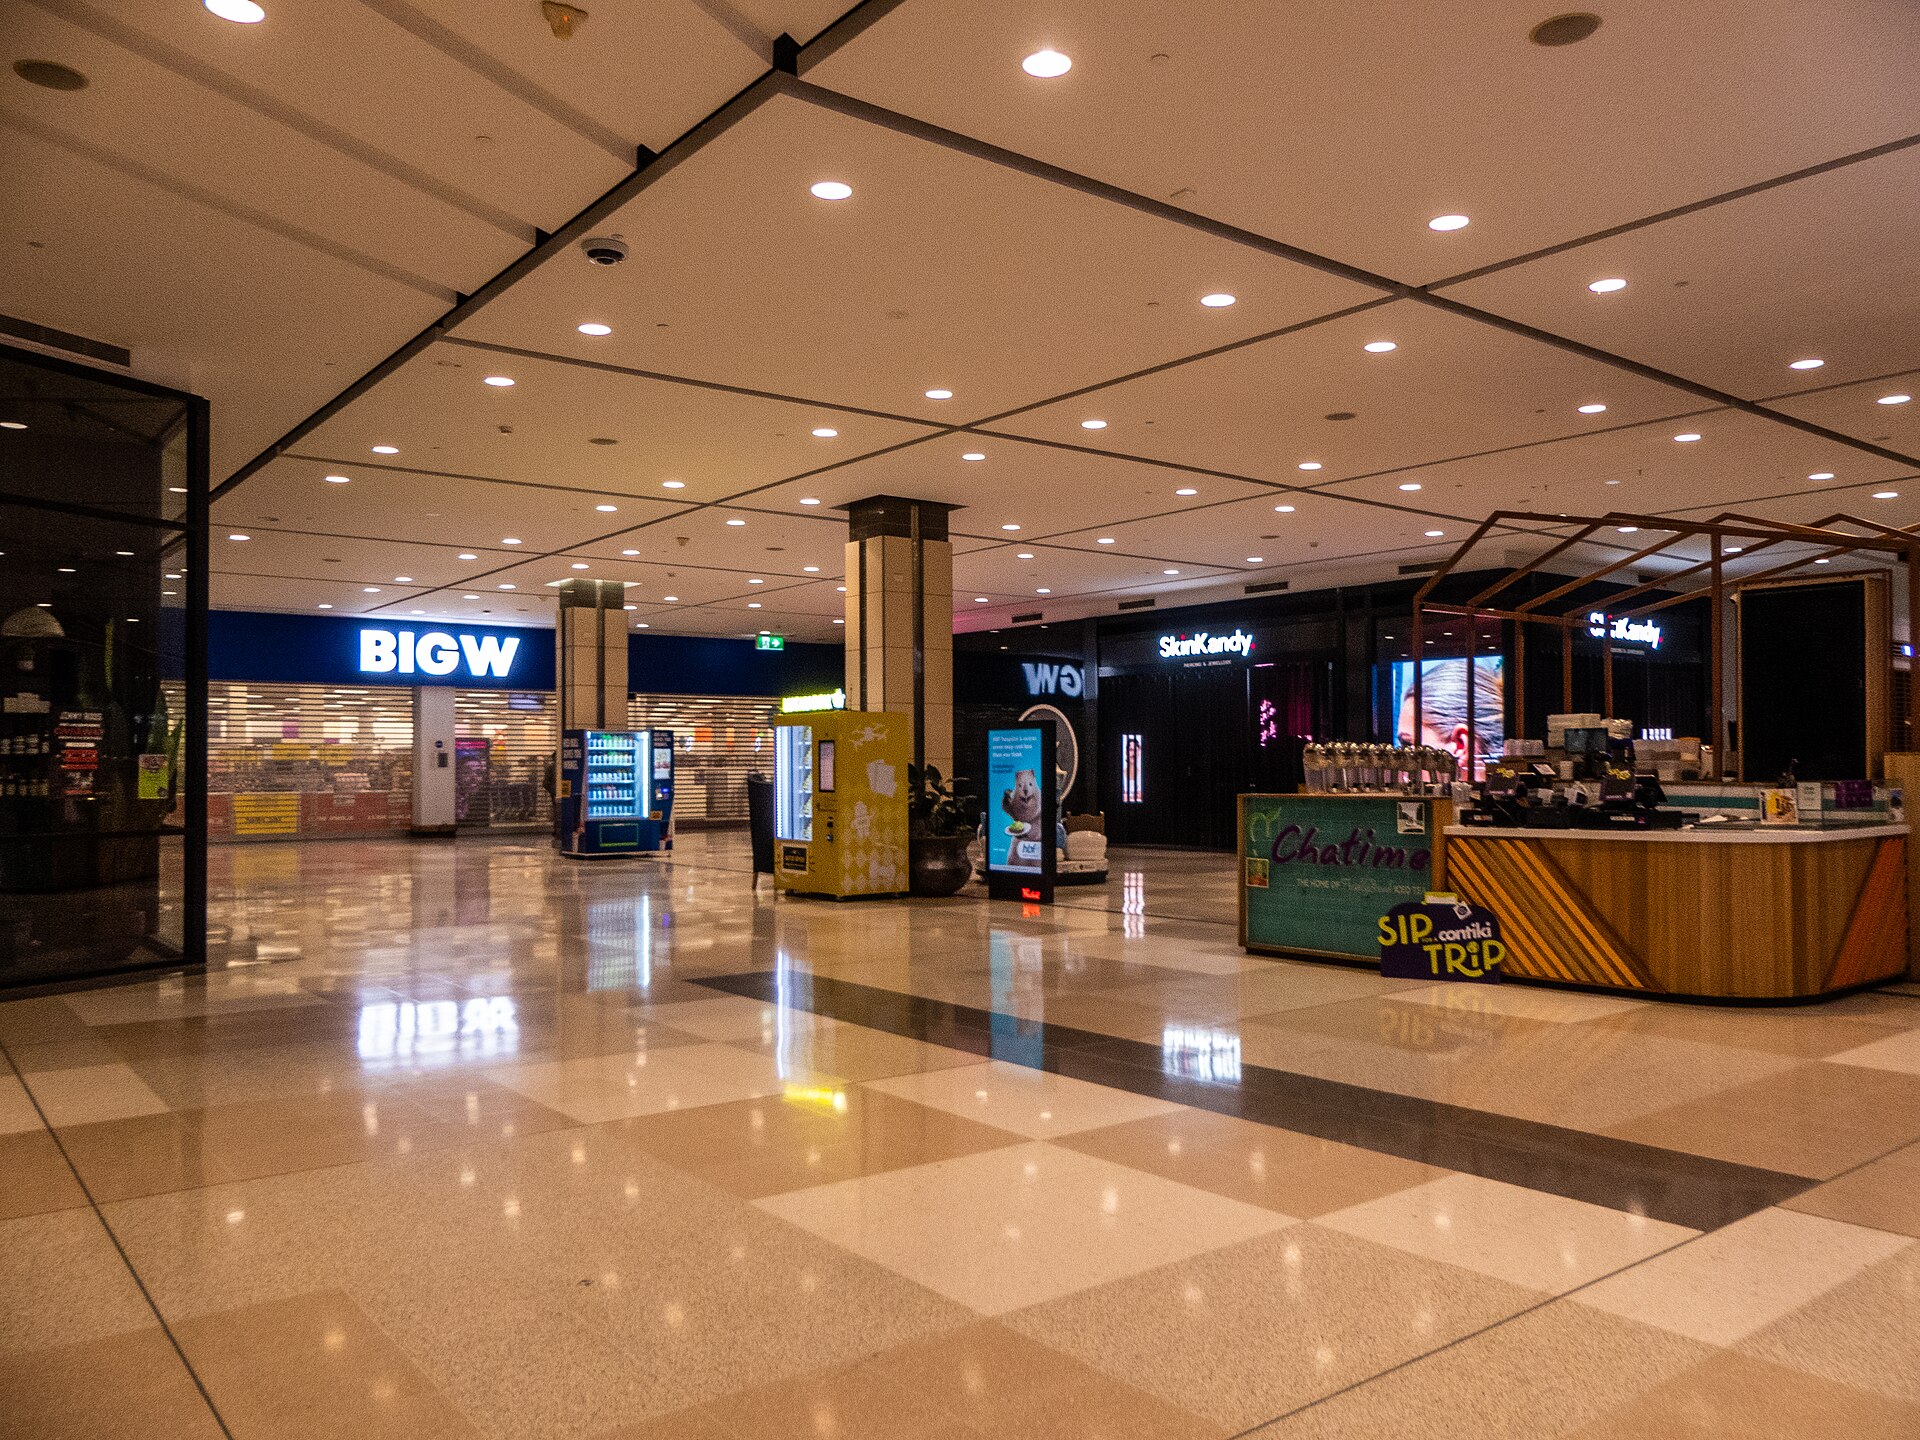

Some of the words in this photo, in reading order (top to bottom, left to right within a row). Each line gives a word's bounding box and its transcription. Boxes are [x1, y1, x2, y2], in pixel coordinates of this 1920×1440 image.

[1271, 824, 1432, 870] Chatime
[1377, 913, 1433, 946] SIP
[1438, 921, 1492, 942] contiki
